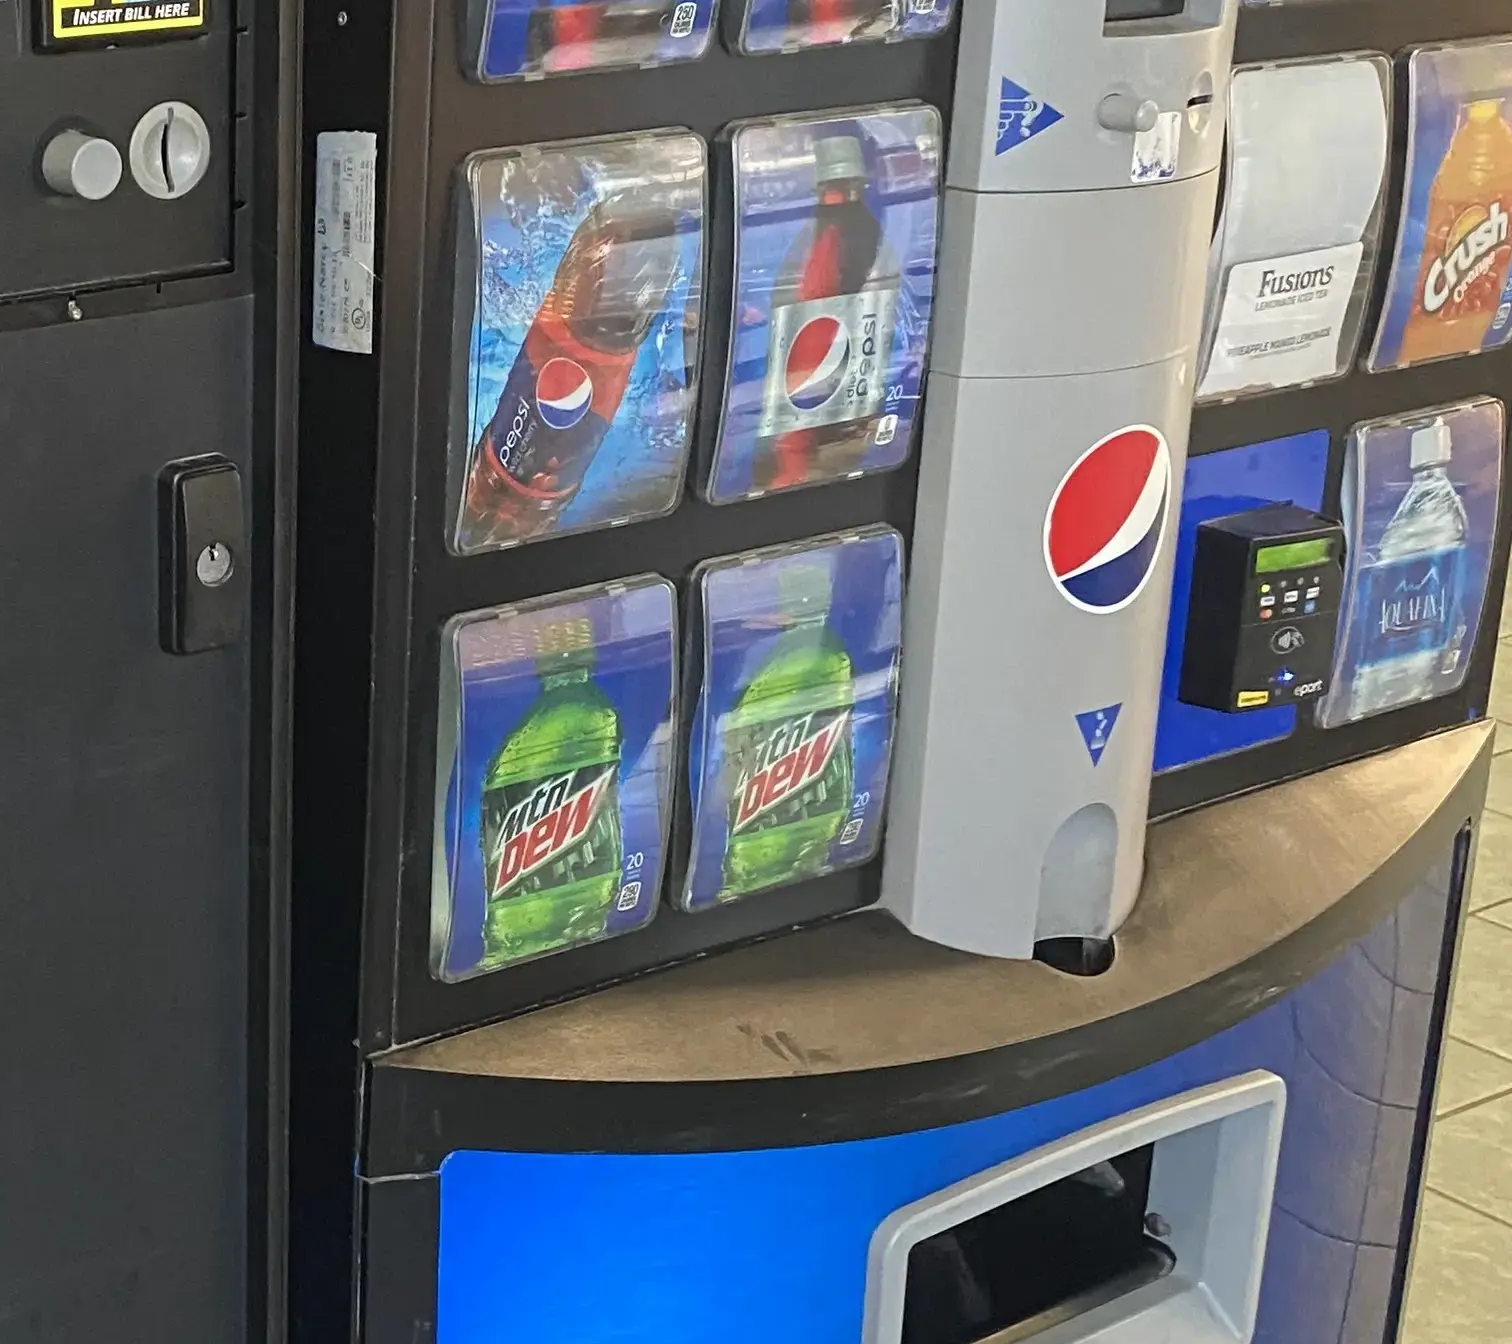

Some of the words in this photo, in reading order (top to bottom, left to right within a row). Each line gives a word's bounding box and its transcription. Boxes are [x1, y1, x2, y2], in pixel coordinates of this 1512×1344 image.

[73, 8, 124, 26] INSERT
[124, 4, 153, 22] BILL
[155, 2, 191, 18] HERE
[1422, 202, 1509, 313] Crush
[1256, 265, 1335, 298] Fusions
[855, 312, 877, 397] pepsi
[885, 385, 904, 402] 20
[499, 396, 531, 468] pepsi
[853, 792, 870, 808] 20
[626, 853, 643, 869] 20
